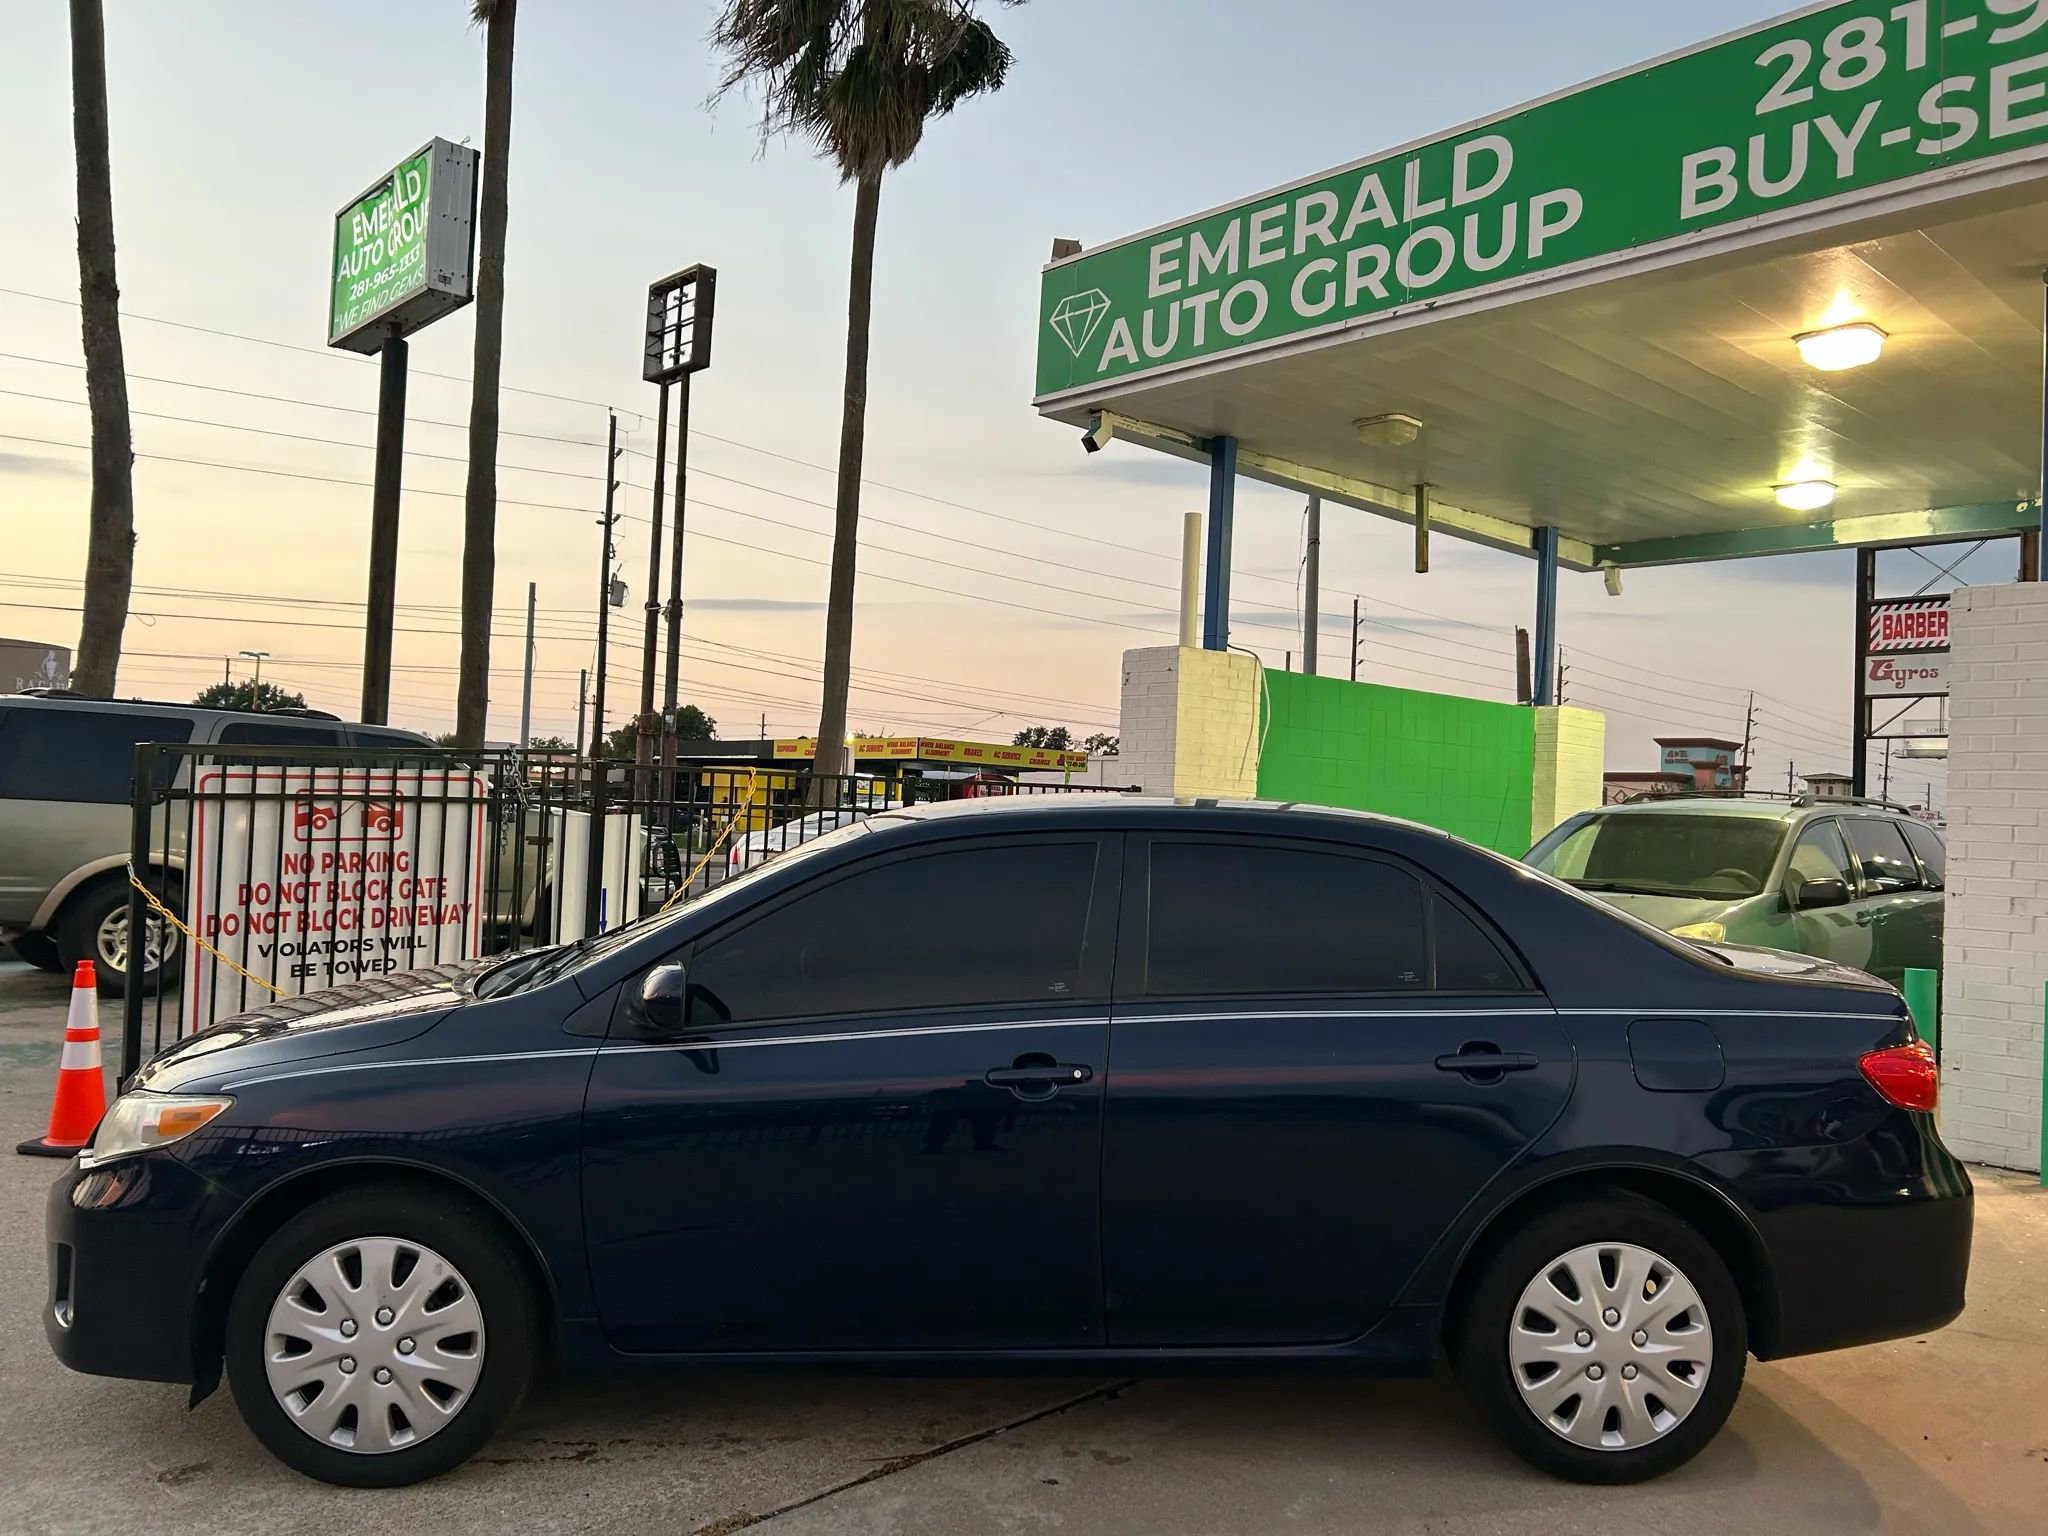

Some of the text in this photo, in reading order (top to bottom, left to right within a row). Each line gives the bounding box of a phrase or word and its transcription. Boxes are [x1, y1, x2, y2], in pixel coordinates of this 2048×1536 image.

[1147, 134, 1514, 299] EMERALD
[337, 237, 384, 283] AUTO
[1097, 187, 1584, 373] AUTO GROUP
[360, 289, 389, 321] FIND
[1882, 610, 1949, 640] BARBER
[1869, 658, 1939, 689] Gyros
[858, 744, 884, 753] AC SERVICE
[993, 751, 1022, 761] AC SERVICE
[283, 850, 409, 876] NO PARKING
[238, 877, 448, 906] DO NOT BLOCK GATE
[206, 903, 473, 937] DO NOT BLOCK DRIVEWAY
[257, 935, 428, 958] VOLATORS WILL
[290, 957, 398, 978] BE TOWED
